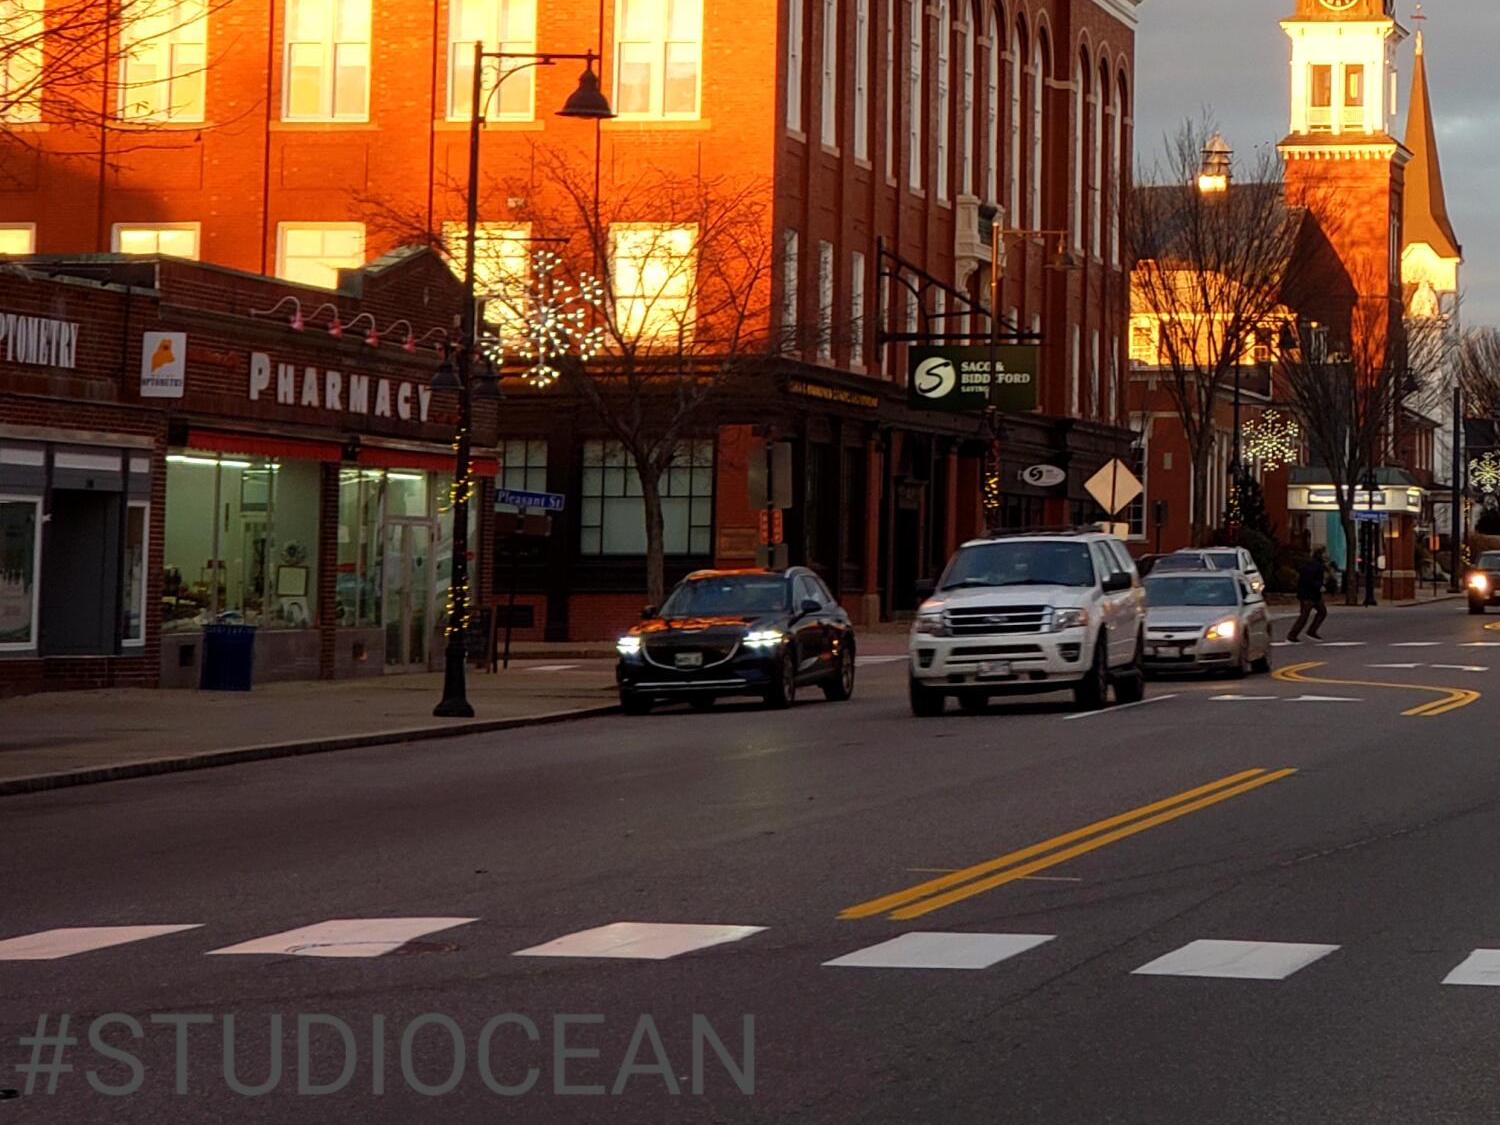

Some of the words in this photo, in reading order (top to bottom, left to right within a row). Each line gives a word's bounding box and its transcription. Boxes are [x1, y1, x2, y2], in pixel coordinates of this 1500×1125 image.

[250, 352, 431, 422] PHARMACY
[961, 373, 1031, 384] BIDDFORD
[497, 490, 545, 507] Pleasant
[549, 496, 561, 508] St
